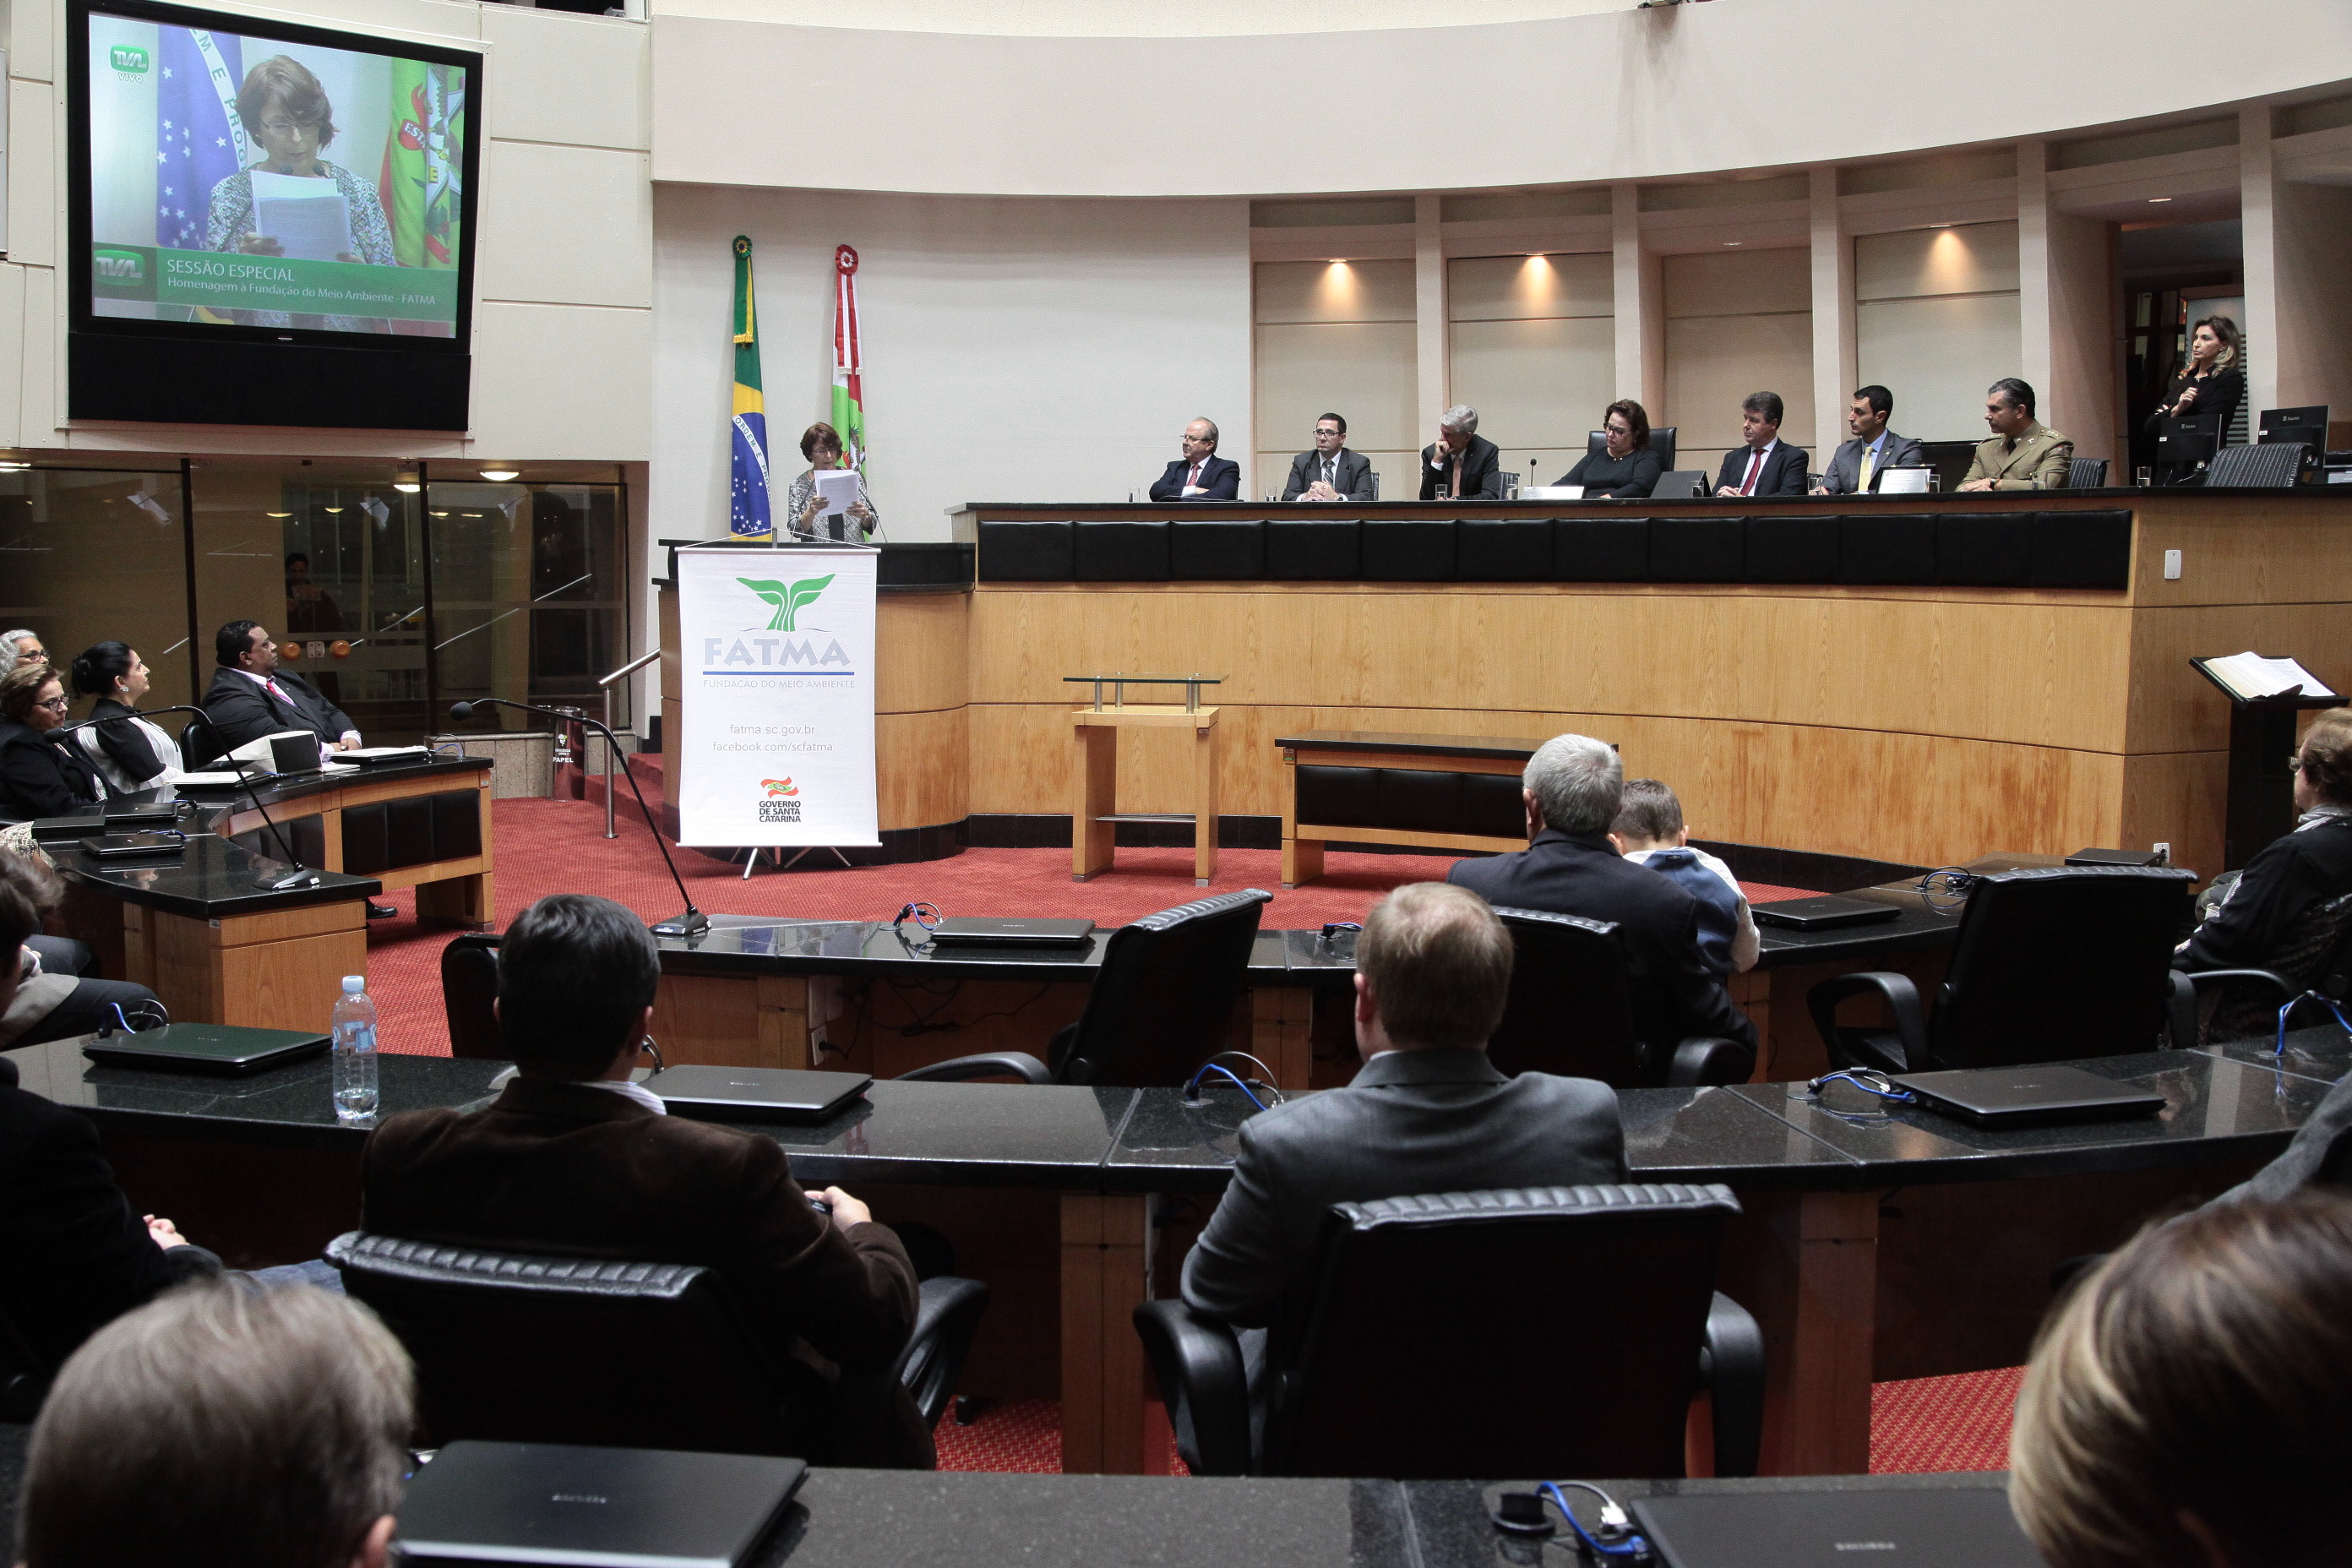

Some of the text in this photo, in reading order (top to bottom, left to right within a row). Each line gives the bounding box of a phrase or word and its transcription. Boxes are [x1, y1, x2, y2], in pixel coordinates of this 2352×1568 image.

[117, 72, 144, 83] VIVO
[167, 259, 295, 282] SESSÃO ESPECIAL
[167, 276, 237, 292] Homenagem
[249, 283, 300, 297] Fundação
[302, 286, 315, 297] do
[318, 287, 343, 299] Meio
[346, 289, 394, 302] Ambiente
[401, 293, 436, 305] FATMA
[704, 637, 851, 667] FATMA
[703, 678, 856, 690] FUNDAÇÃO DO MEIO AMBIENTE
[729, 724, 816, 737] fatma.sc.gov.br
[713, 741, 833, 753] facebook.com/scfatma
